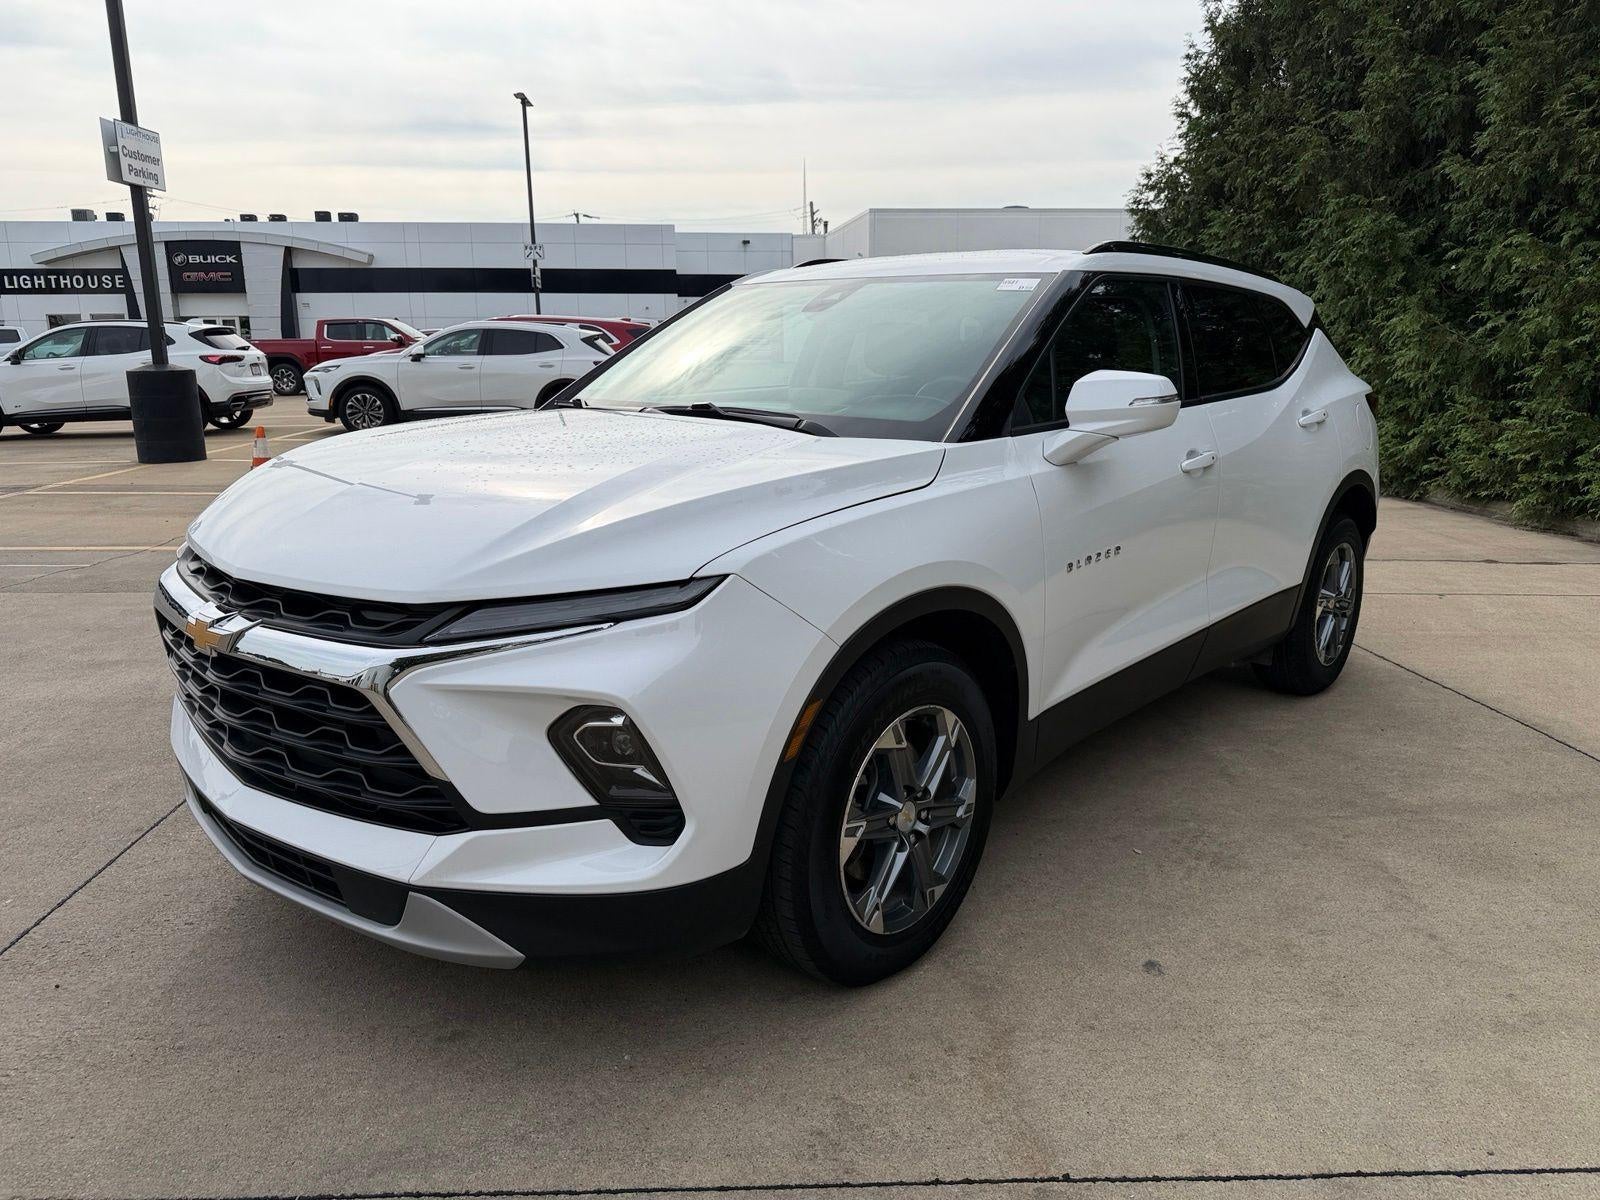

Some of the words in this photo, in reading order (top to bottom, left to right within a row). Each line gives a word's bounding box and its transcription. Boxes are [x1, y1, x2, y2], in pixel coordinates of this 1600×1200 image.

[126, 127, 160, 144] LIGHTHOUSE
[121, 144, 160, 166] Customer
[127, 163, 159, 185] Parking
[188, 254, 238, 264] BUICK
[3, 275, 125, 289] LIGHTHOUSE
[182, 271, 233, 282] GMC
[1066, 545, 1122, 573] BLAZER
